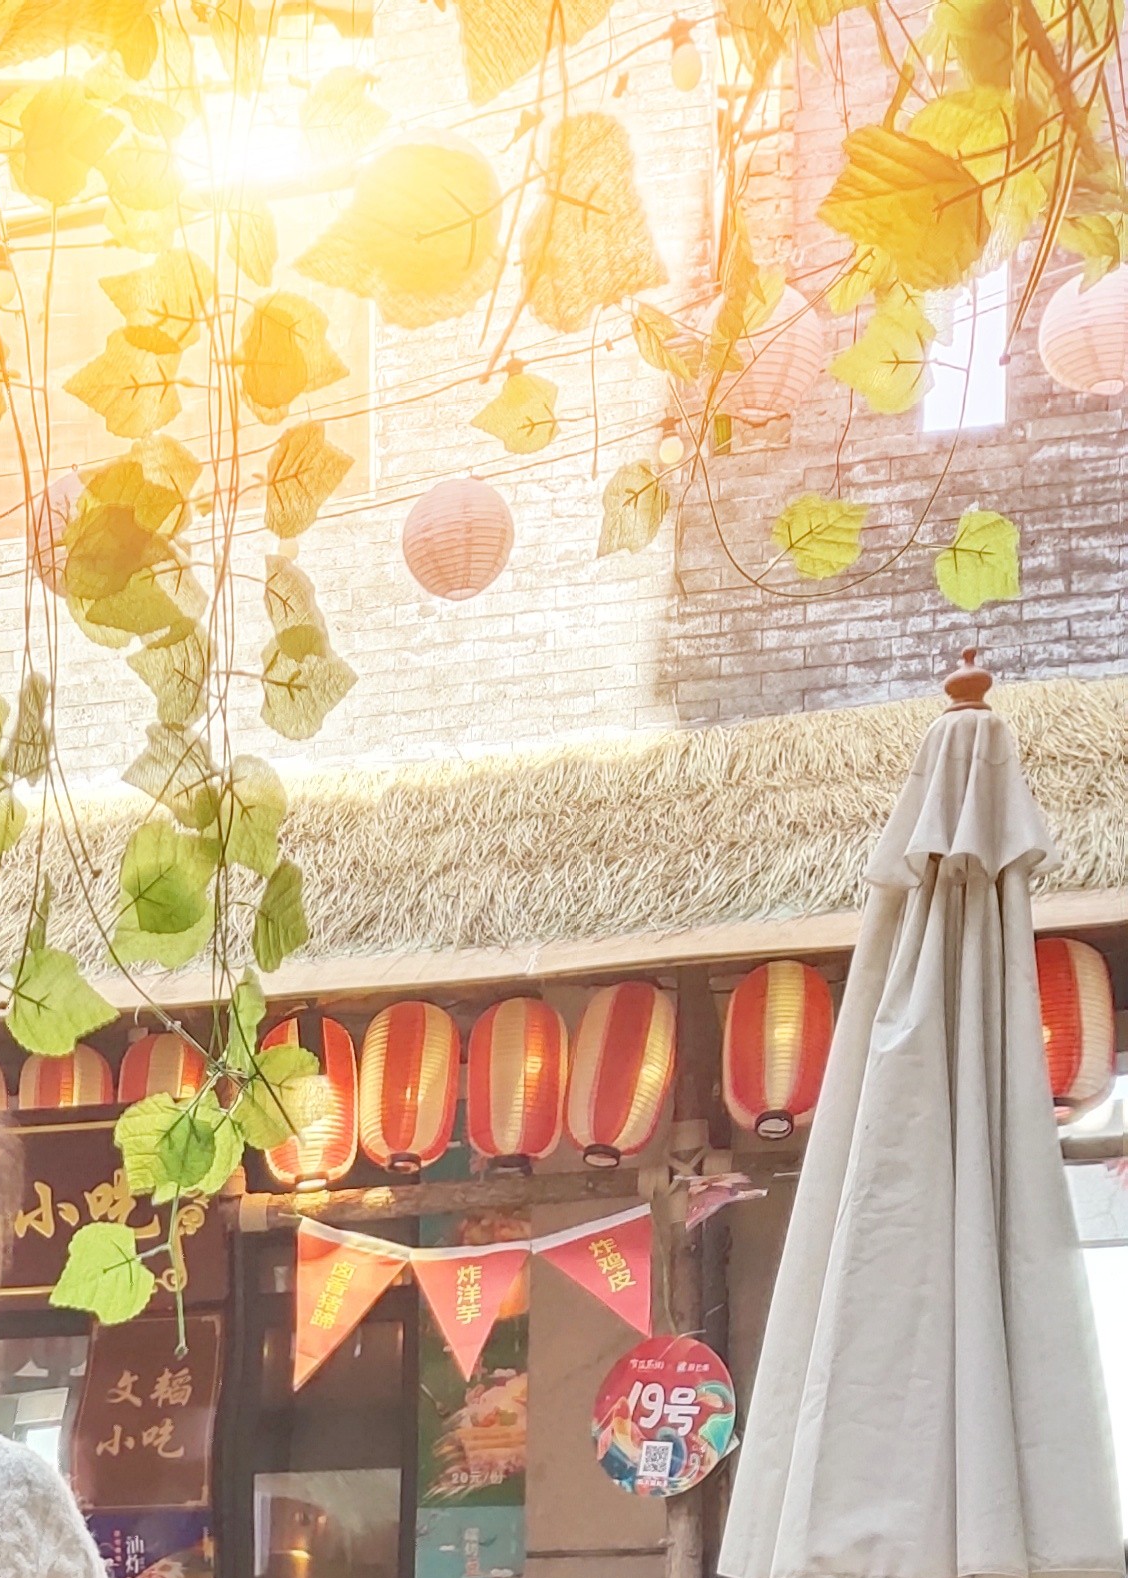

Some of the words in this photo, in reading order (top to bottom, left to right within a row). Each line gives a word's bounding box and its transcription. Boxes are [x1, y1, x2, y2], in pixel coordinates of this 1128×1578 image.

[588, 1237, 637, 1293] 炸鸡皮
[455, 1264, 481, 1324] 炸洋芋
[628, 1381, 700, 1436] 19号
[96, 1417, 184, 1458] 小吃
